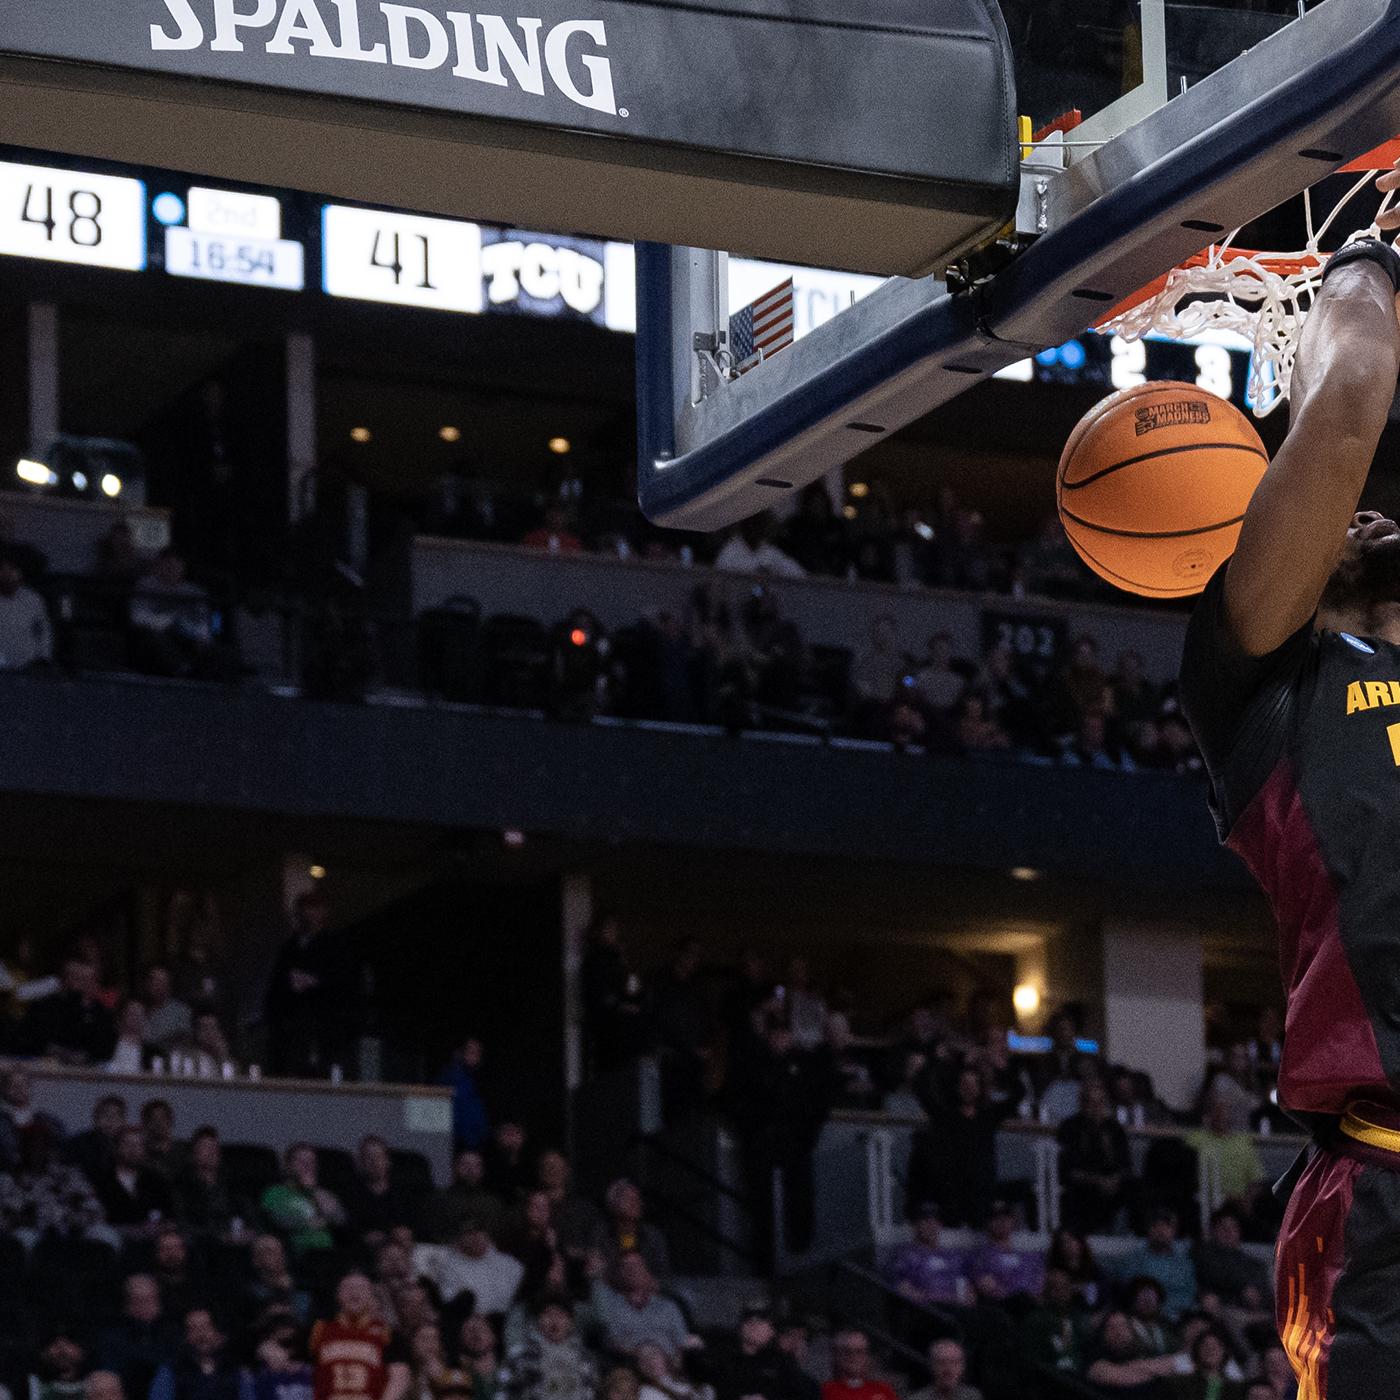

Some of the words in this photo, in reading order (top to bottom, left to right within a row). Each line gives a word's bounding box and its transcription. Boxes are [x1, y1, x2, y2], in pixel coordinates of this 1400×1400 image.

[149, 0, 617, 116] SPALDING
[20, 182, 103, 248] 48
[370, 229, 437, 290] 41
[481, 241, 604, 313] TCU
